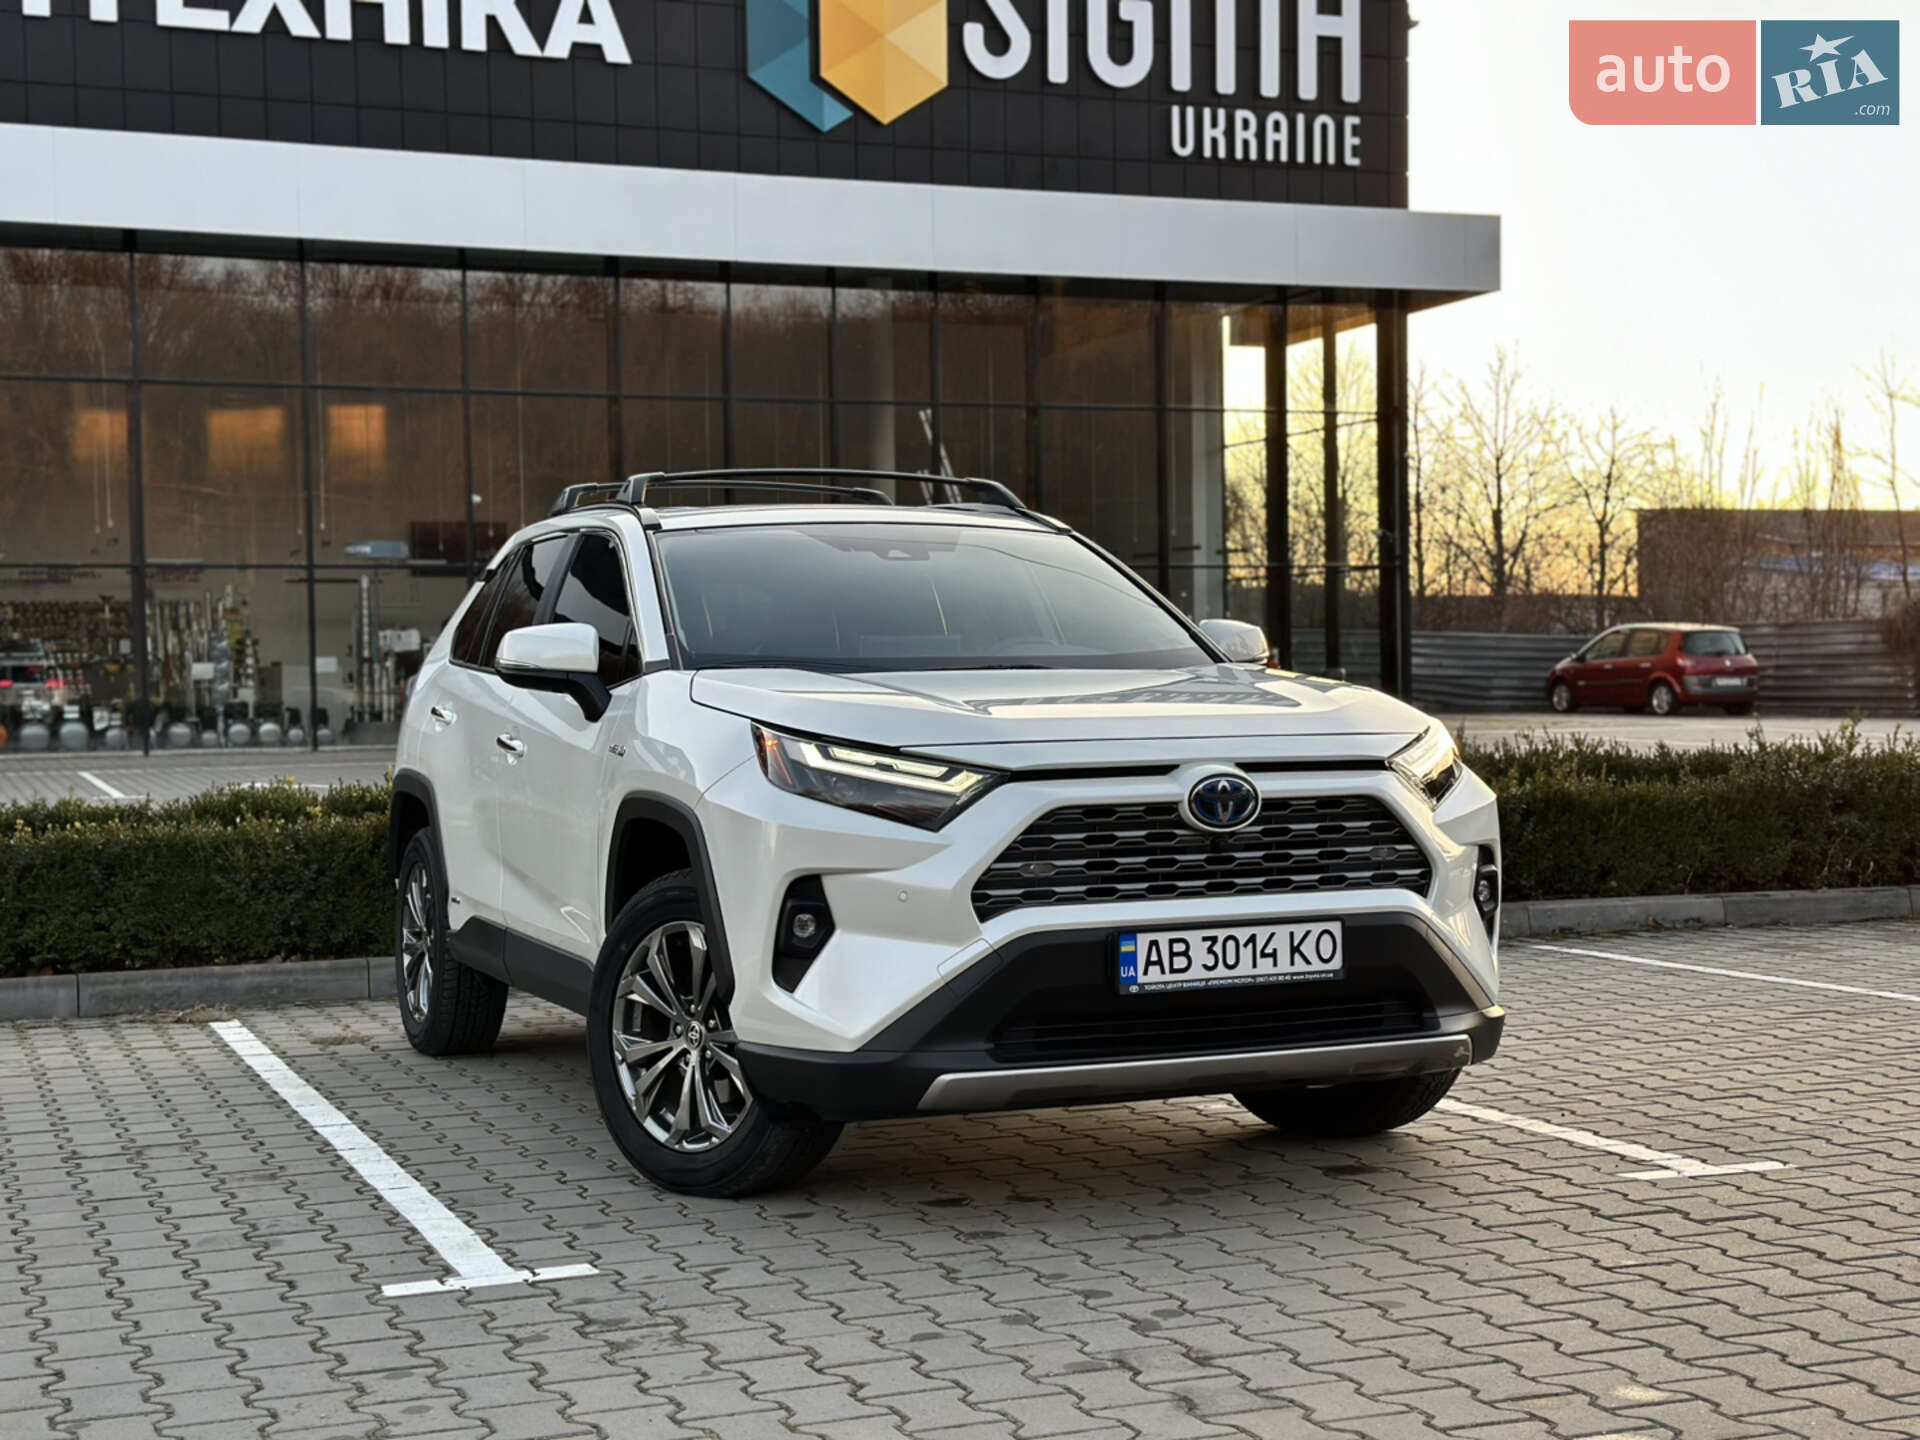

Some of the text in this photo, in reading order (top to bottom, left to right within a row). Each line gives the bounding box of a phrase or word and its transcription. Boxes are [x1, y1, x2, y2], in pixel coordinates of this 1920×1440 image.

[1171, 105, 1361, 167] UKRAINE
[1120, 966, 1136, 978] UA
[1142, 928, 1338, 976] AB 3014 KO
